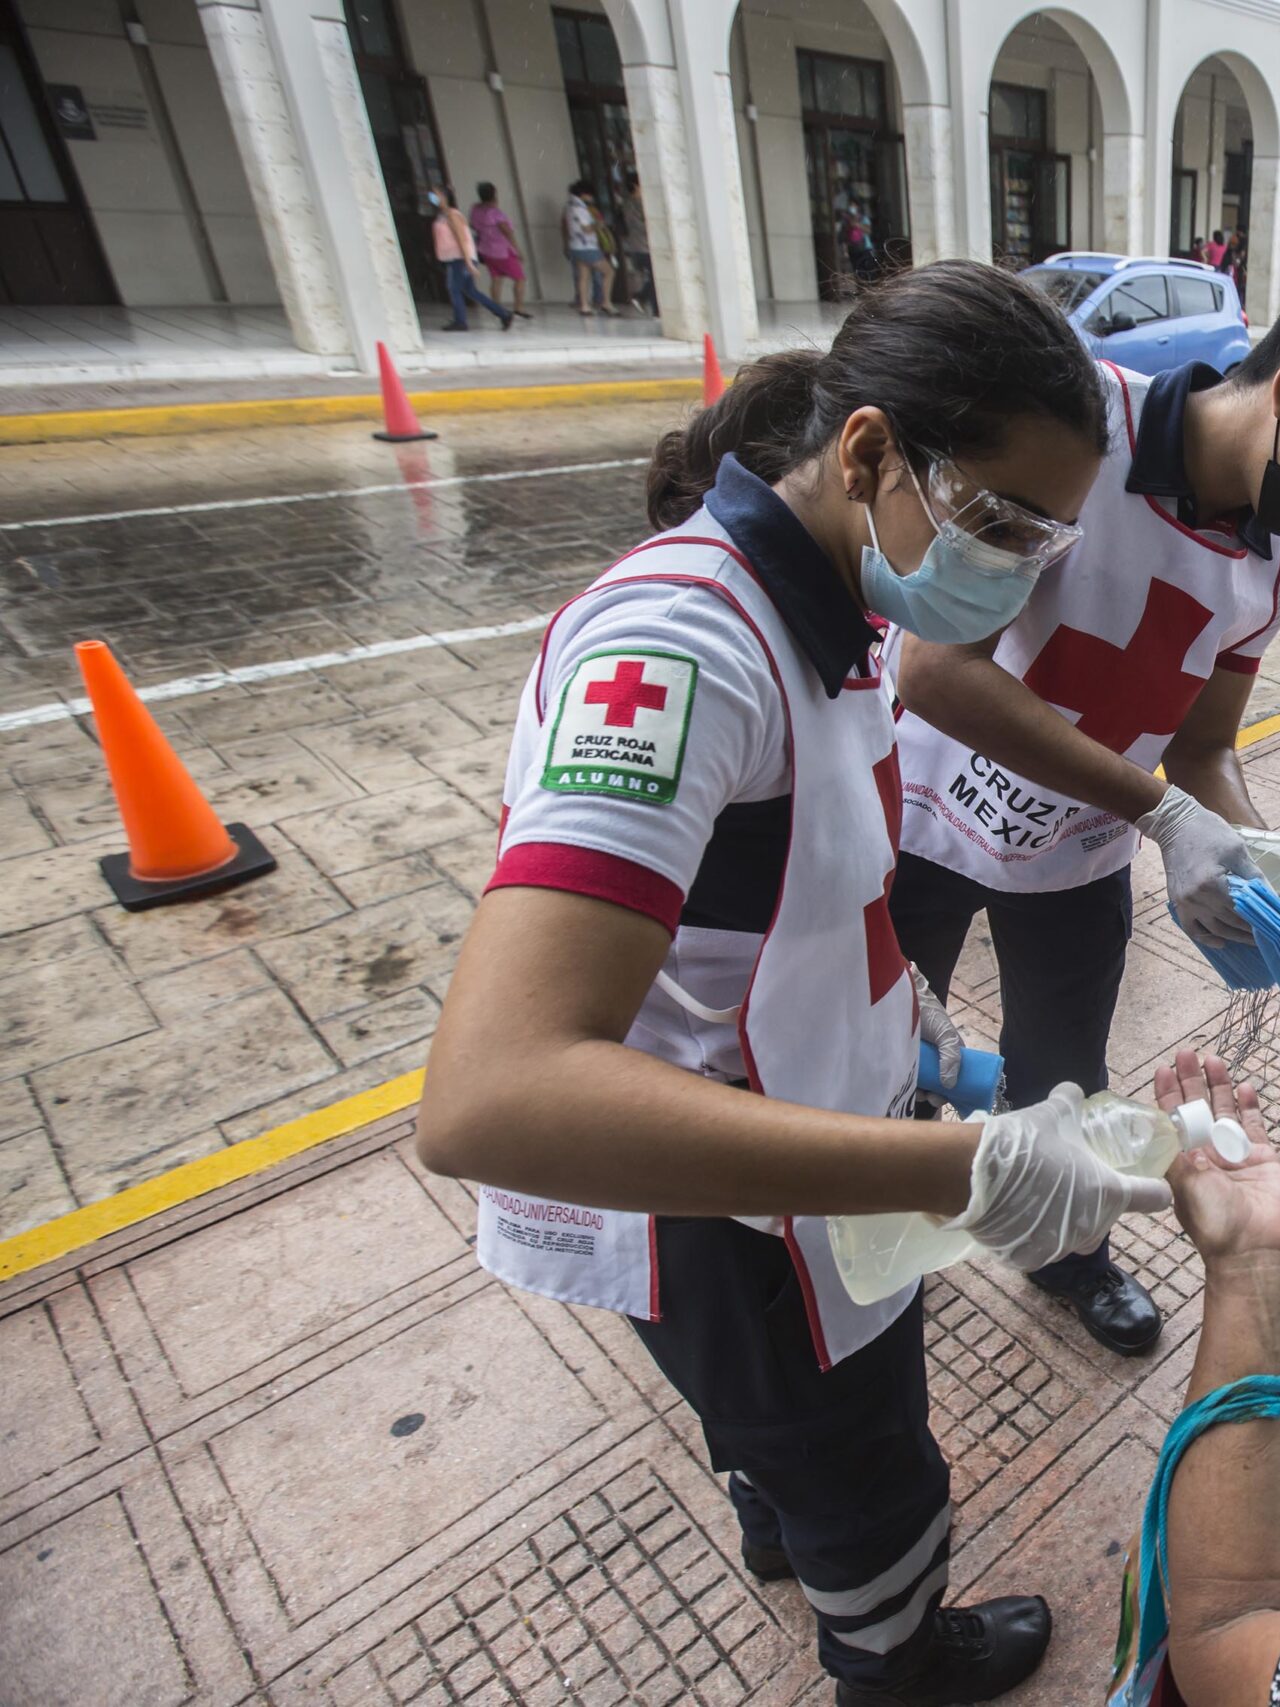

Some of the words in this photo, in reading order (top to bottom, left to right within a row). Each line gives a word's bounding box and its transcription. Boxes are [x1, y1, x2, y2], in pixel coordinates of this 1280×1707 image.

[575, 735, 613, 746] CRUZ
[617, 737, 656, 753] ROJA
[571, 748, 654, 767] MEXICANA
[559, 772, 659, 793] ALUMNO
[970, 752, 1057, 827] CRUZ
